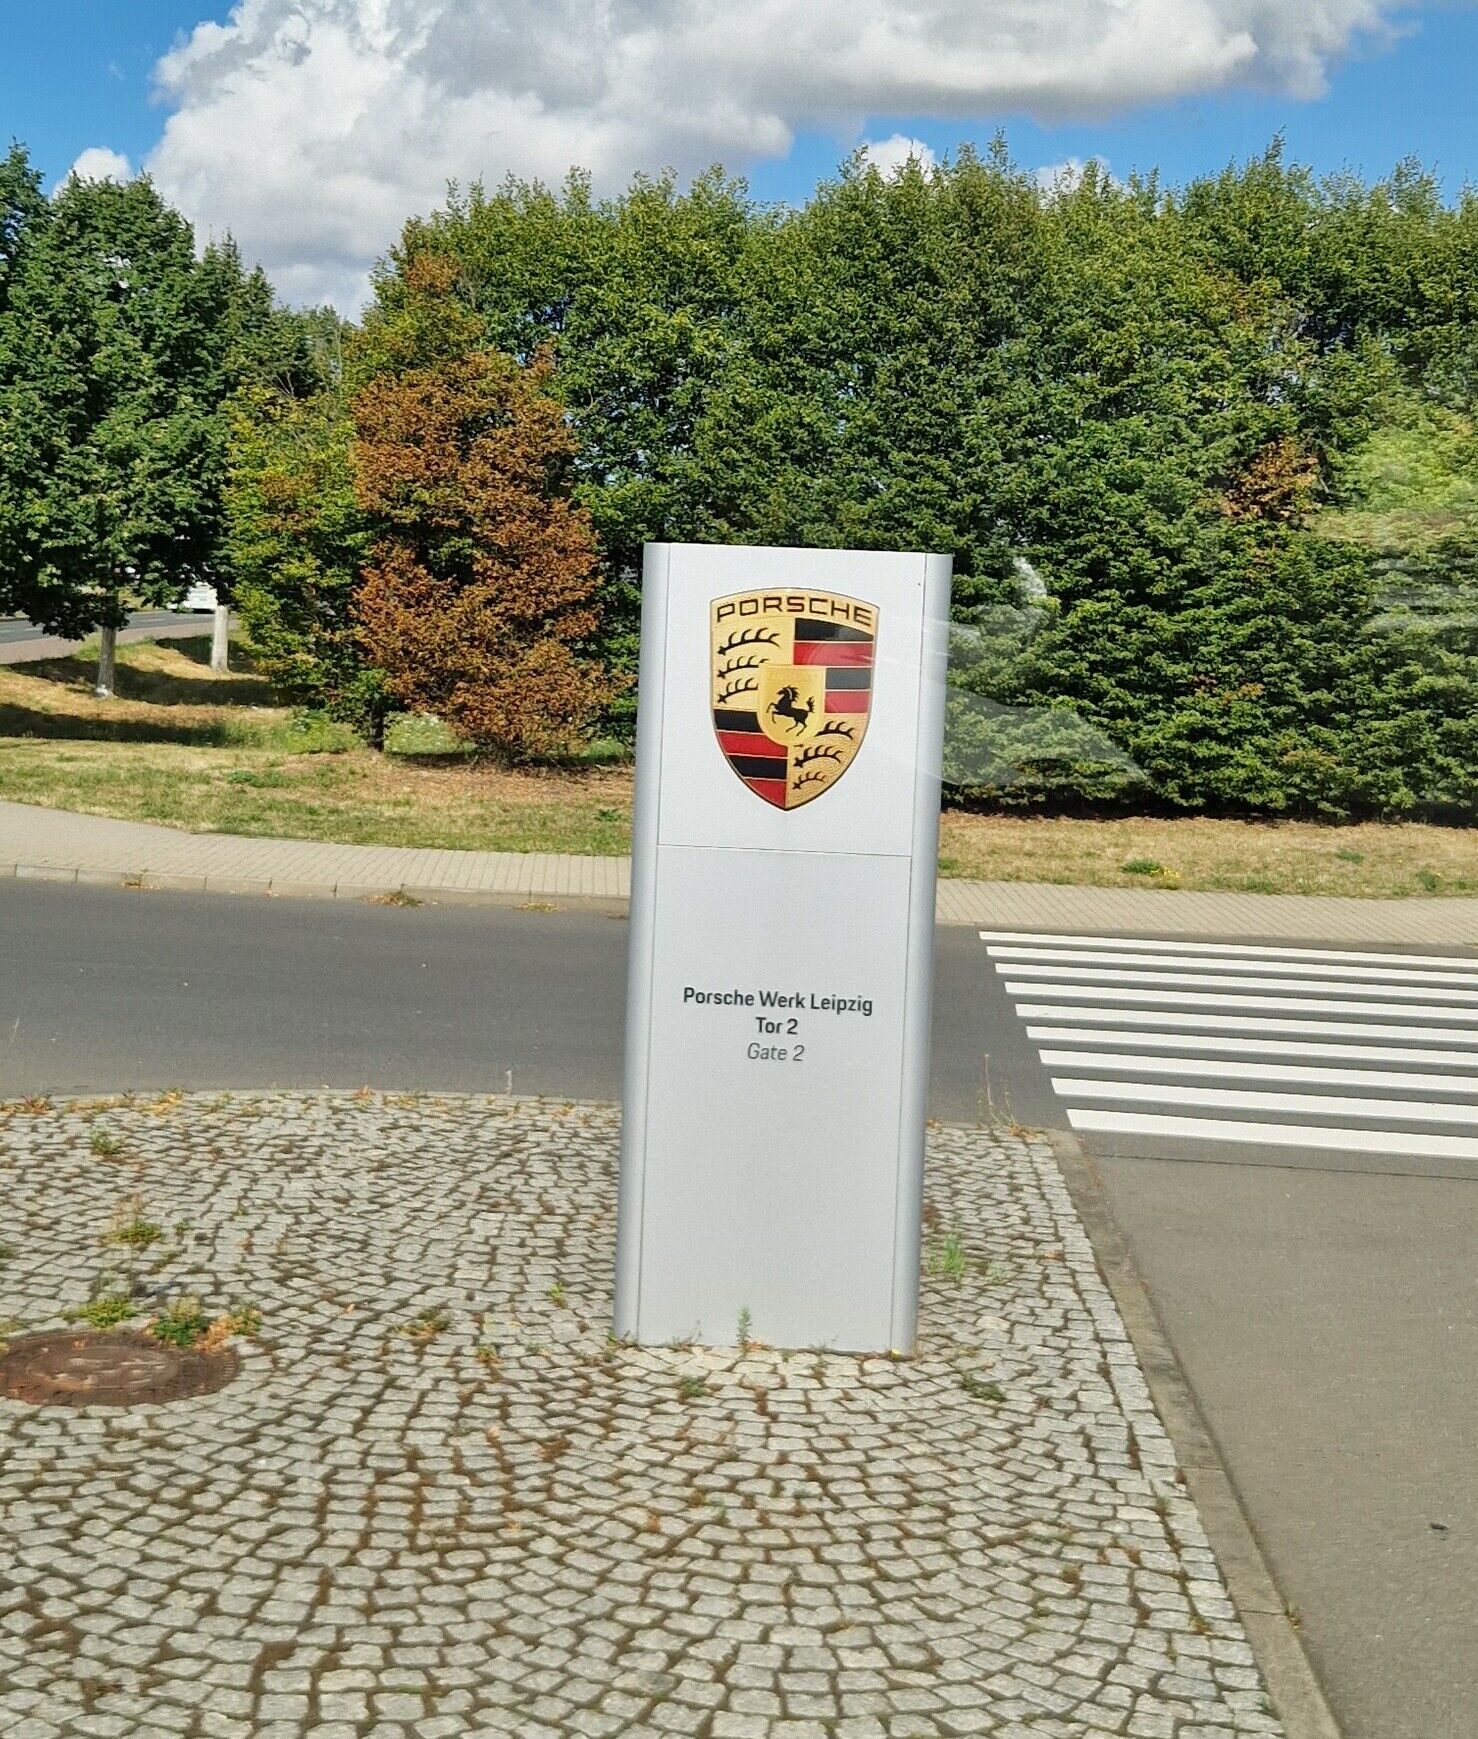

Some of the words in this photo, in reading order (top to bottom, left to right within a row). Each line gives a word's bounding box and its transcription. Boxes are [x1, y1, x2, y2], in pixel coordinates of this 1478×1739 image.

[716, 596, 873, 627] PORSCHE
[683, 987, 755, 1006] Porsche
[759, 990, 806, 1009] Werk
[810, 993, 873, 1017] Leipzig
[755, 1016, 783, 1034] Tor
[786, 1018, 799, 1035] 2
[747, 1042, 788, 1061] Gate
[792, 1044, 805, 1062] 2
